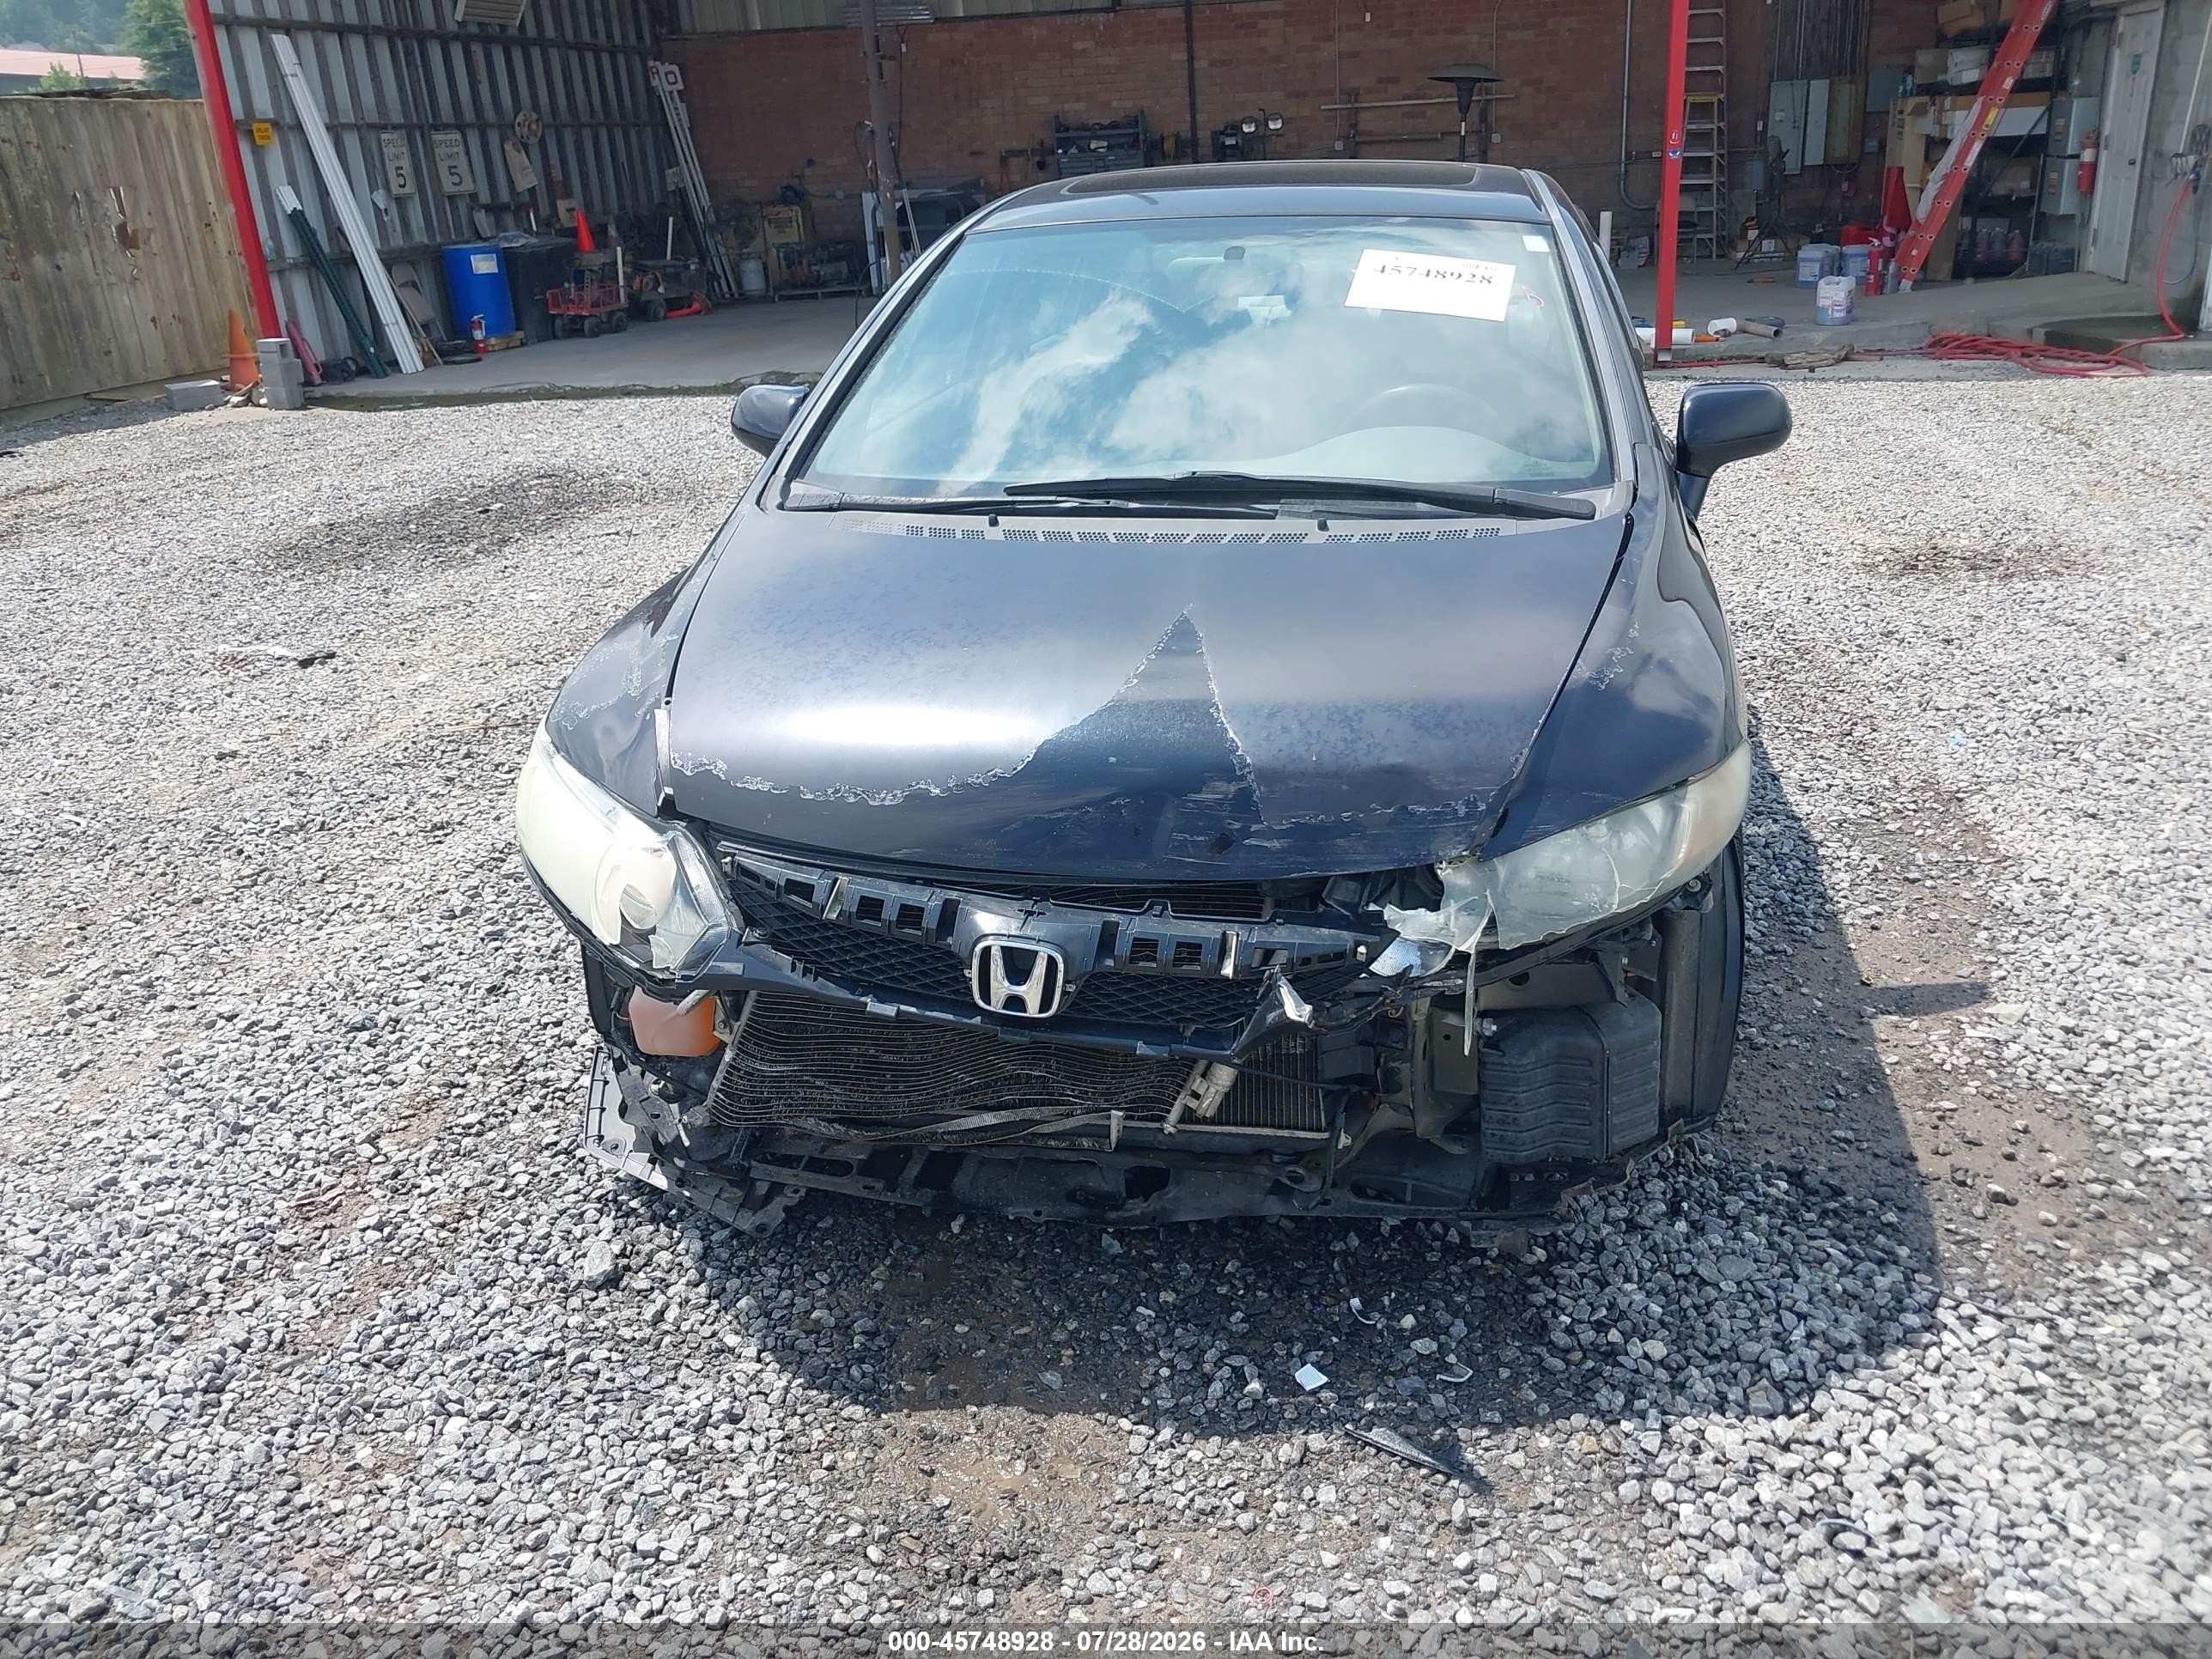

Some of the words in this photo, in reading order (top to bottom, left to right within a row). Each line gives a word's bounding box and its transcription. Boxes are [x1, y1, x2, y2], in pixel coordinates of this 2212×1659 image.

[434, 137, 461, 149] SPEED
[386, 150, 405, 162] LIMIT
[438, 151, 459, 162] LIMIT
[394, 166, 407, 189] 5
[447, 165, 464, 187] 5
[1373, 264, 1494, 284] 45748928
